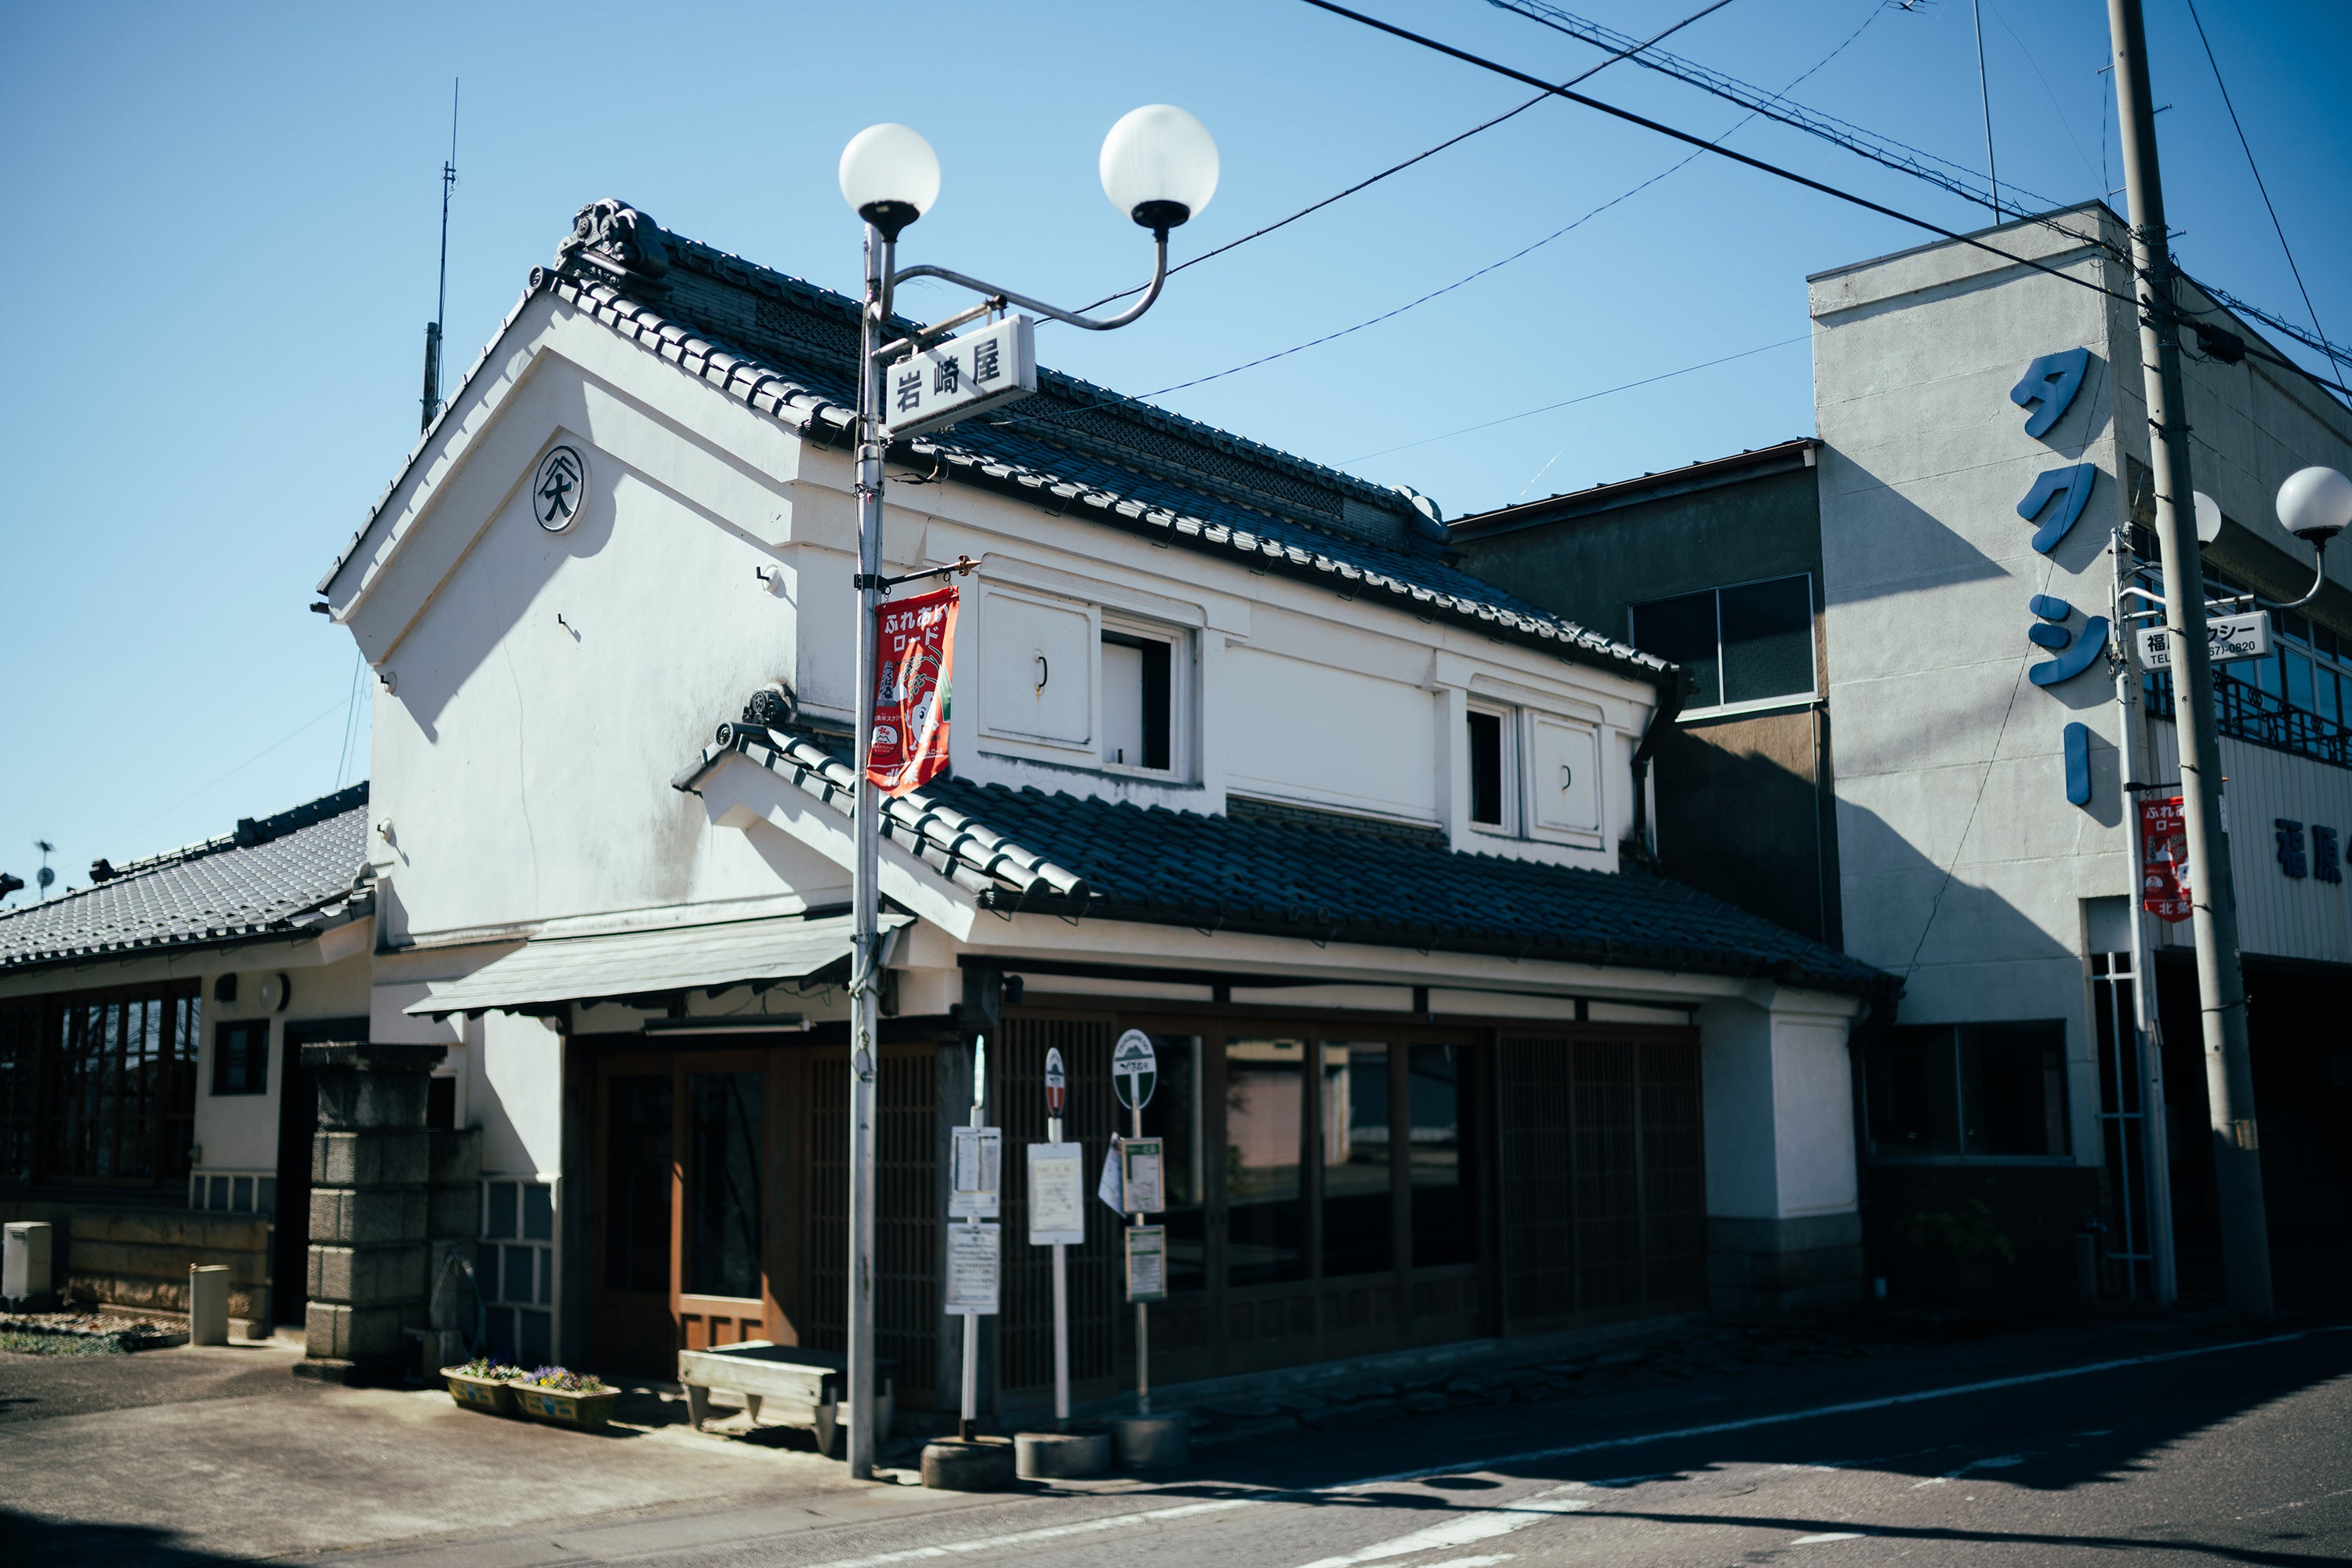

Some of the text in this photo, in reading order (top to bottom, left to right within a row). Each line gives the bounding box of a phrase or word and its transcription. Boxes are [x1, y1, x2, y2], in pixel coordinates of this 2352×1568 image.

[897, 338, 1000, 412] 岩崎屋
[2010, 347, 2109, 807] タクシー
[884, 603, 949, 634] ふれあい
[894, 626, 938, 652] ロード
[2151, 654, 2171, 664] TEL
